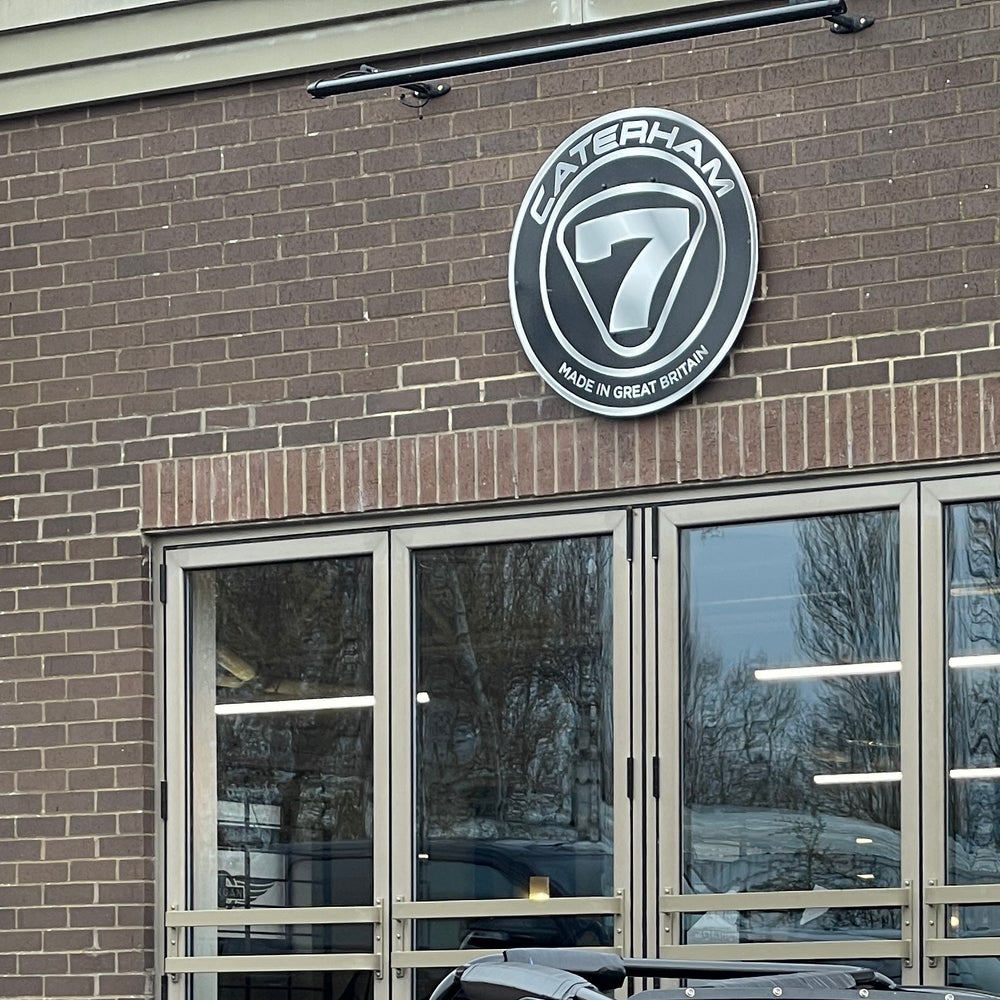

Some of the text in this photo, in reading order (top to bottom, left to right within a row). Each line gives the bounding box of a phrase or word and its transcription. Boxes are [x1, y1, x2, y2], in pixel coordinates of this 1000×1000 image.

[530, 119, 735, 225] CATERHAM
[575, 207, 691, 333] 7
[558, 344, 710, 399] MADE IN GREAT BRITAIN
